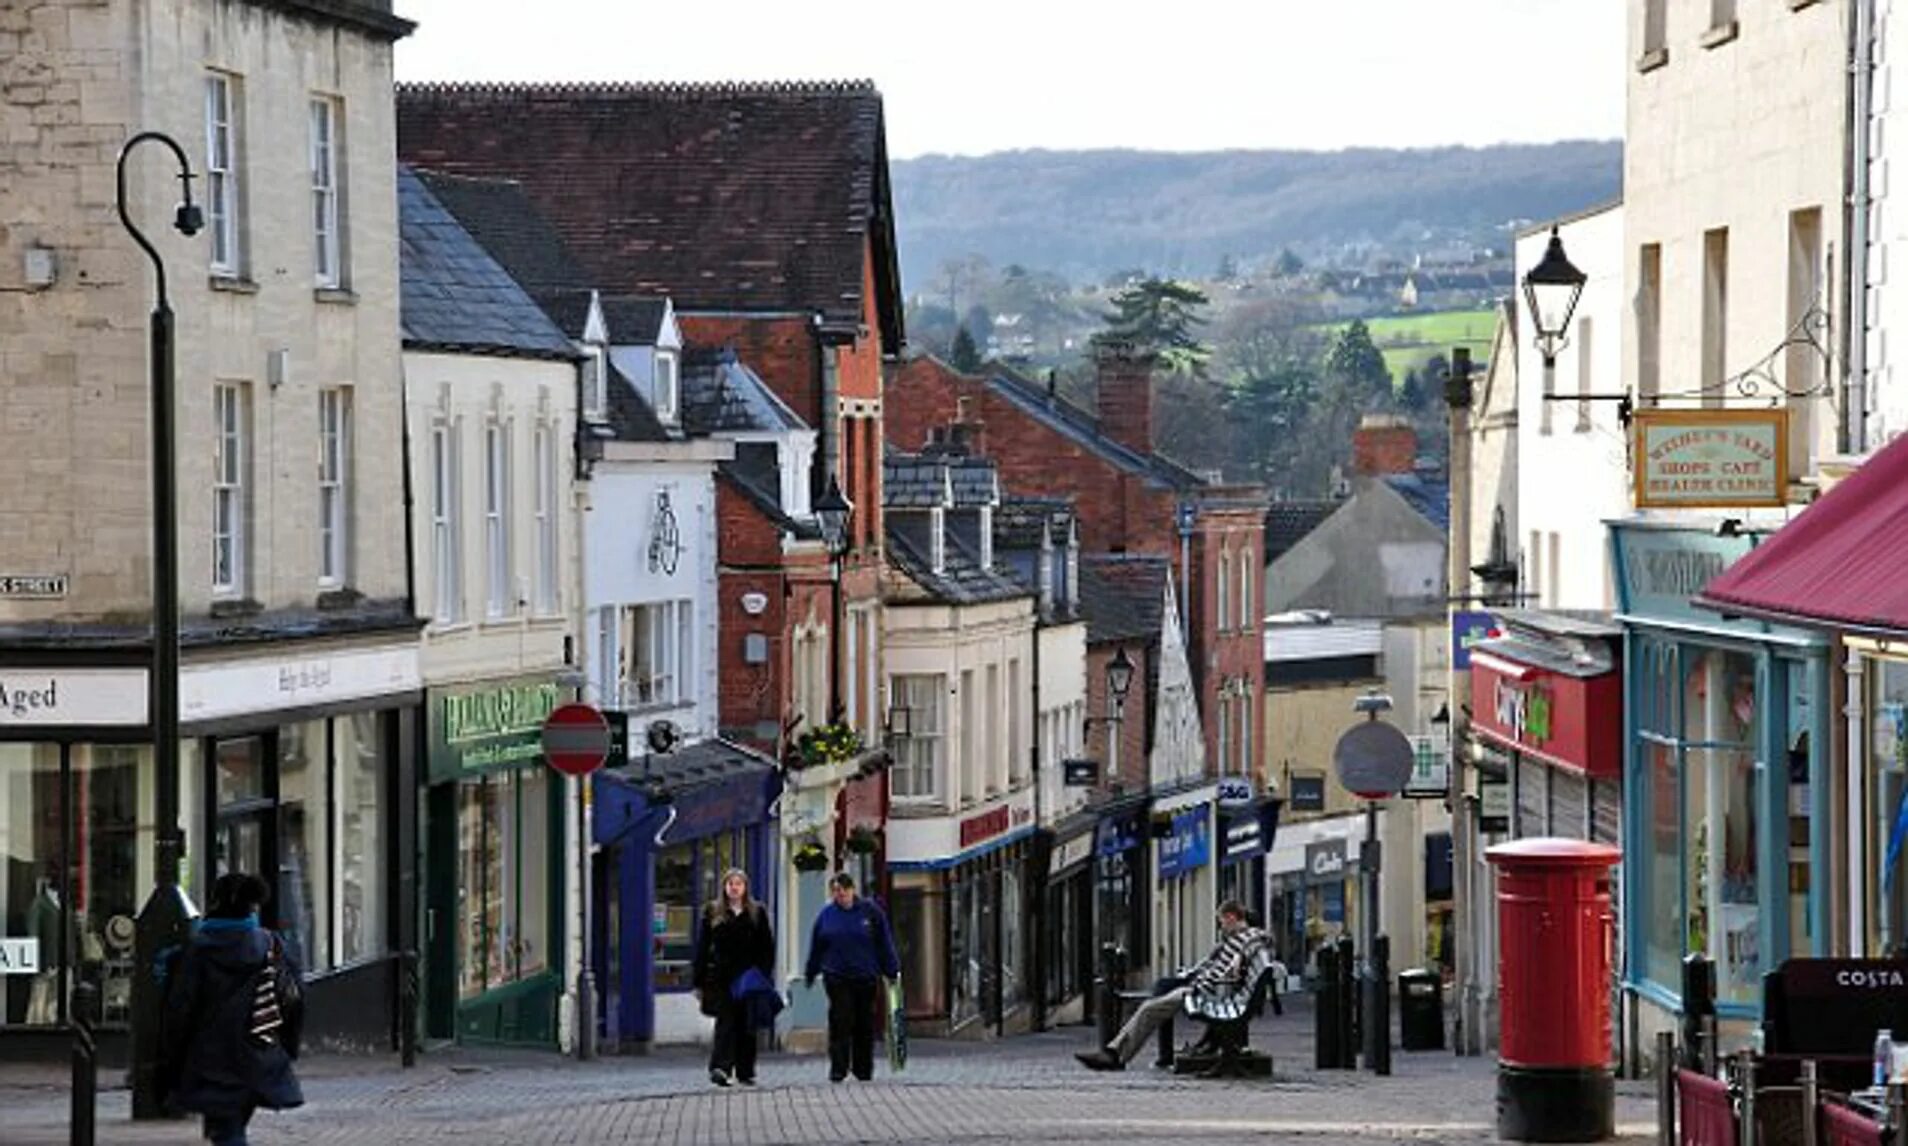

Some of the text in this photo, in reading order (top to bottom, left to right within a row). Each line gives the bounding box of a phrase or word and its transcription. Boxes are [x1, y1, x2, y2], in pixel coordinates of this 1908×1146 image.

[1734, 432, 1776, 460] YARD
[1659, 462, 1711, 475] SHOPS
[1650, 479, 1776, 493] HEALTH CLINIC
[1836, 971, 1904, 988] COSTA
